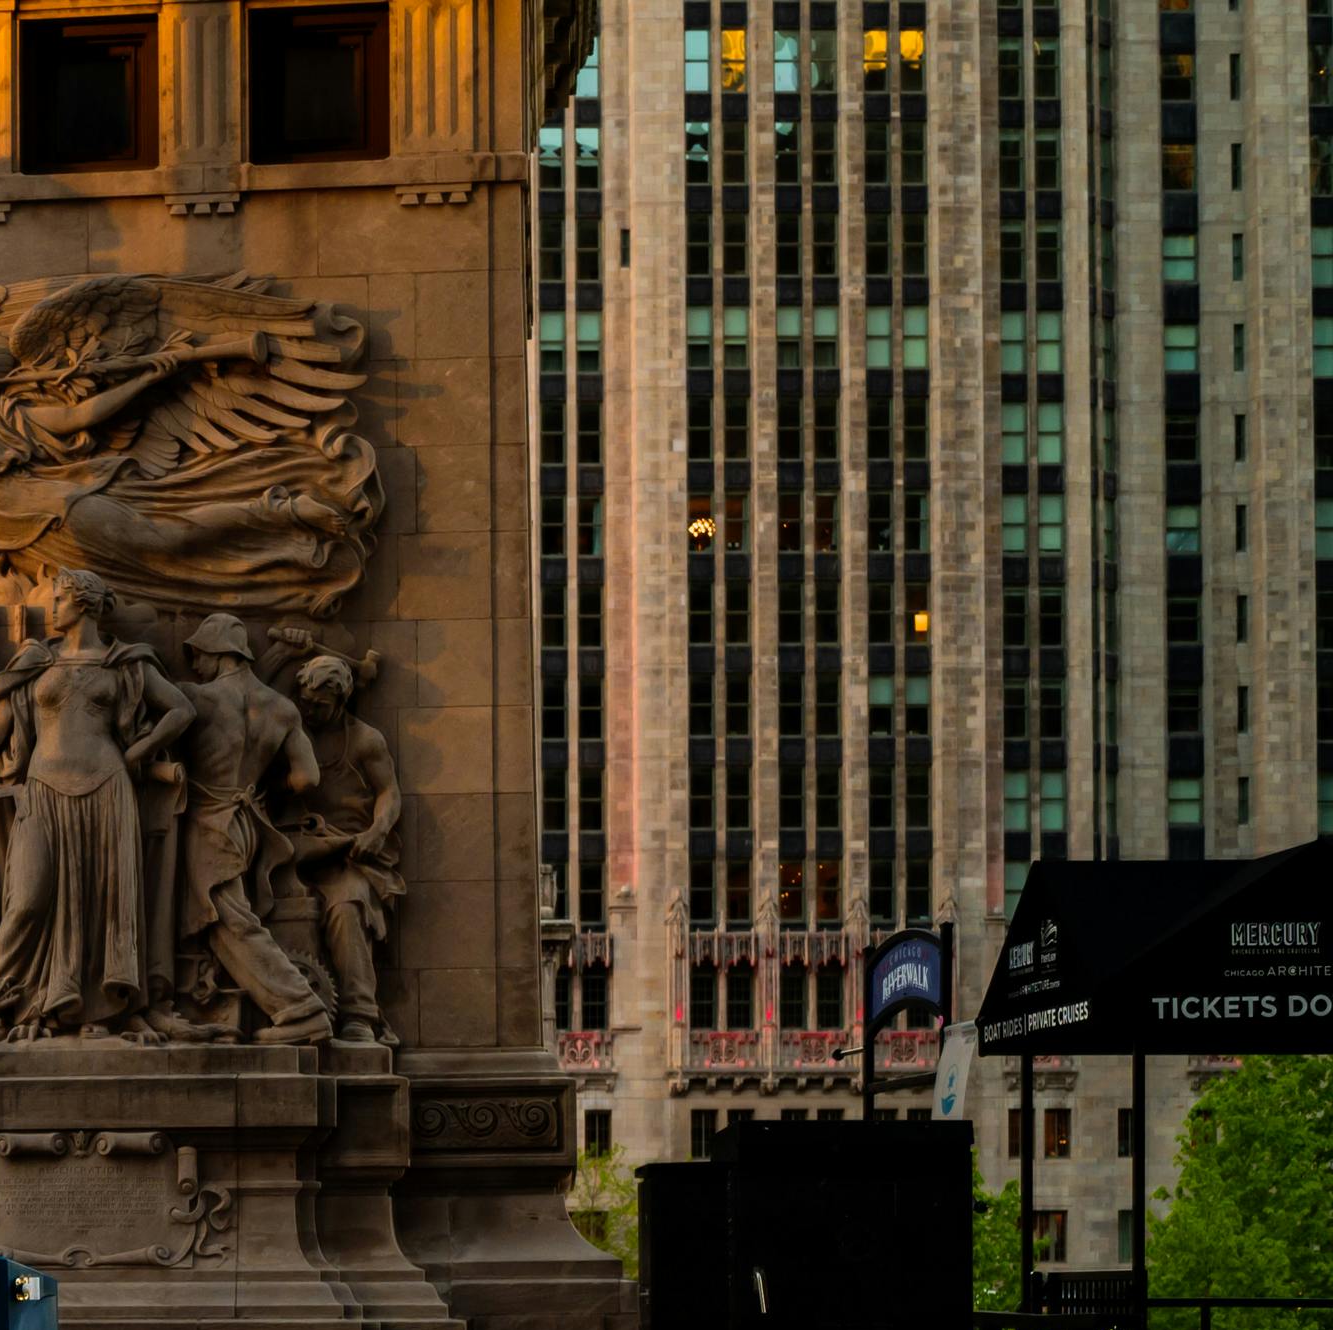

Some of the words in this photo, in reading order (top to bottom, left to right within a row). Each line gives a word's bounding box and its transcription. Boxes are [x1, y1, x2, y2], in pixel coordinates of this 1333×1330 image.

[1231, 921, 1321, 946] MERCURY
[889, 946, 922, 965] CHICAGO
[882, 963, 929, 1004] RIVERWALK
[1224, 969, 1265, 977] CHICAGO
[1151, 995, 1278, 1020] TICKETS
[1288, 994, 1332, 1017] DO
[984, 1022, 1001, 1043] BOAT
[1002, 1017, 1023, 1039] RIDES
[1028, 1008, 1057, 1032] PRIVATE
[1057, 1001, 1089, 1026] CRUISES
